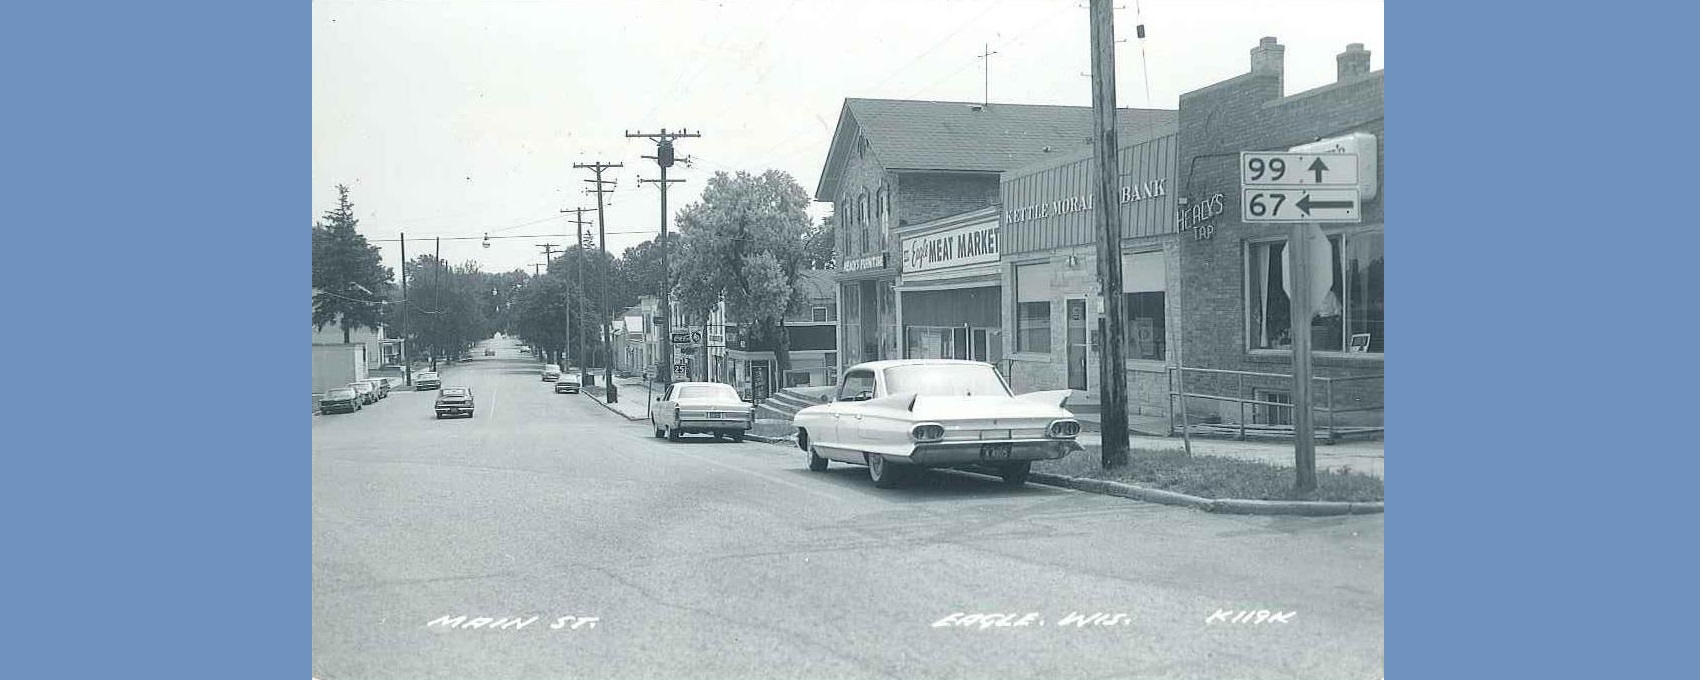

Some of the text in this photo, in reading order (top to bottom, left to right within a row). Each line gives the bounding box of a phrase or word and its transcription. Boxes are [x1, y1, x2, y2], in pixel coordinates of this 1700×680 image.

[1248, 158, 1286, 181] 99
[1005, 178, 1167, 224] KETTLE MORAI BANK
[1249, 193, 1287, 216] 67
[1193, 225, 1214, 240] TAP
[928, 236, 953, 263] MEAT
[957, 227, 1000, 259] MARKET
